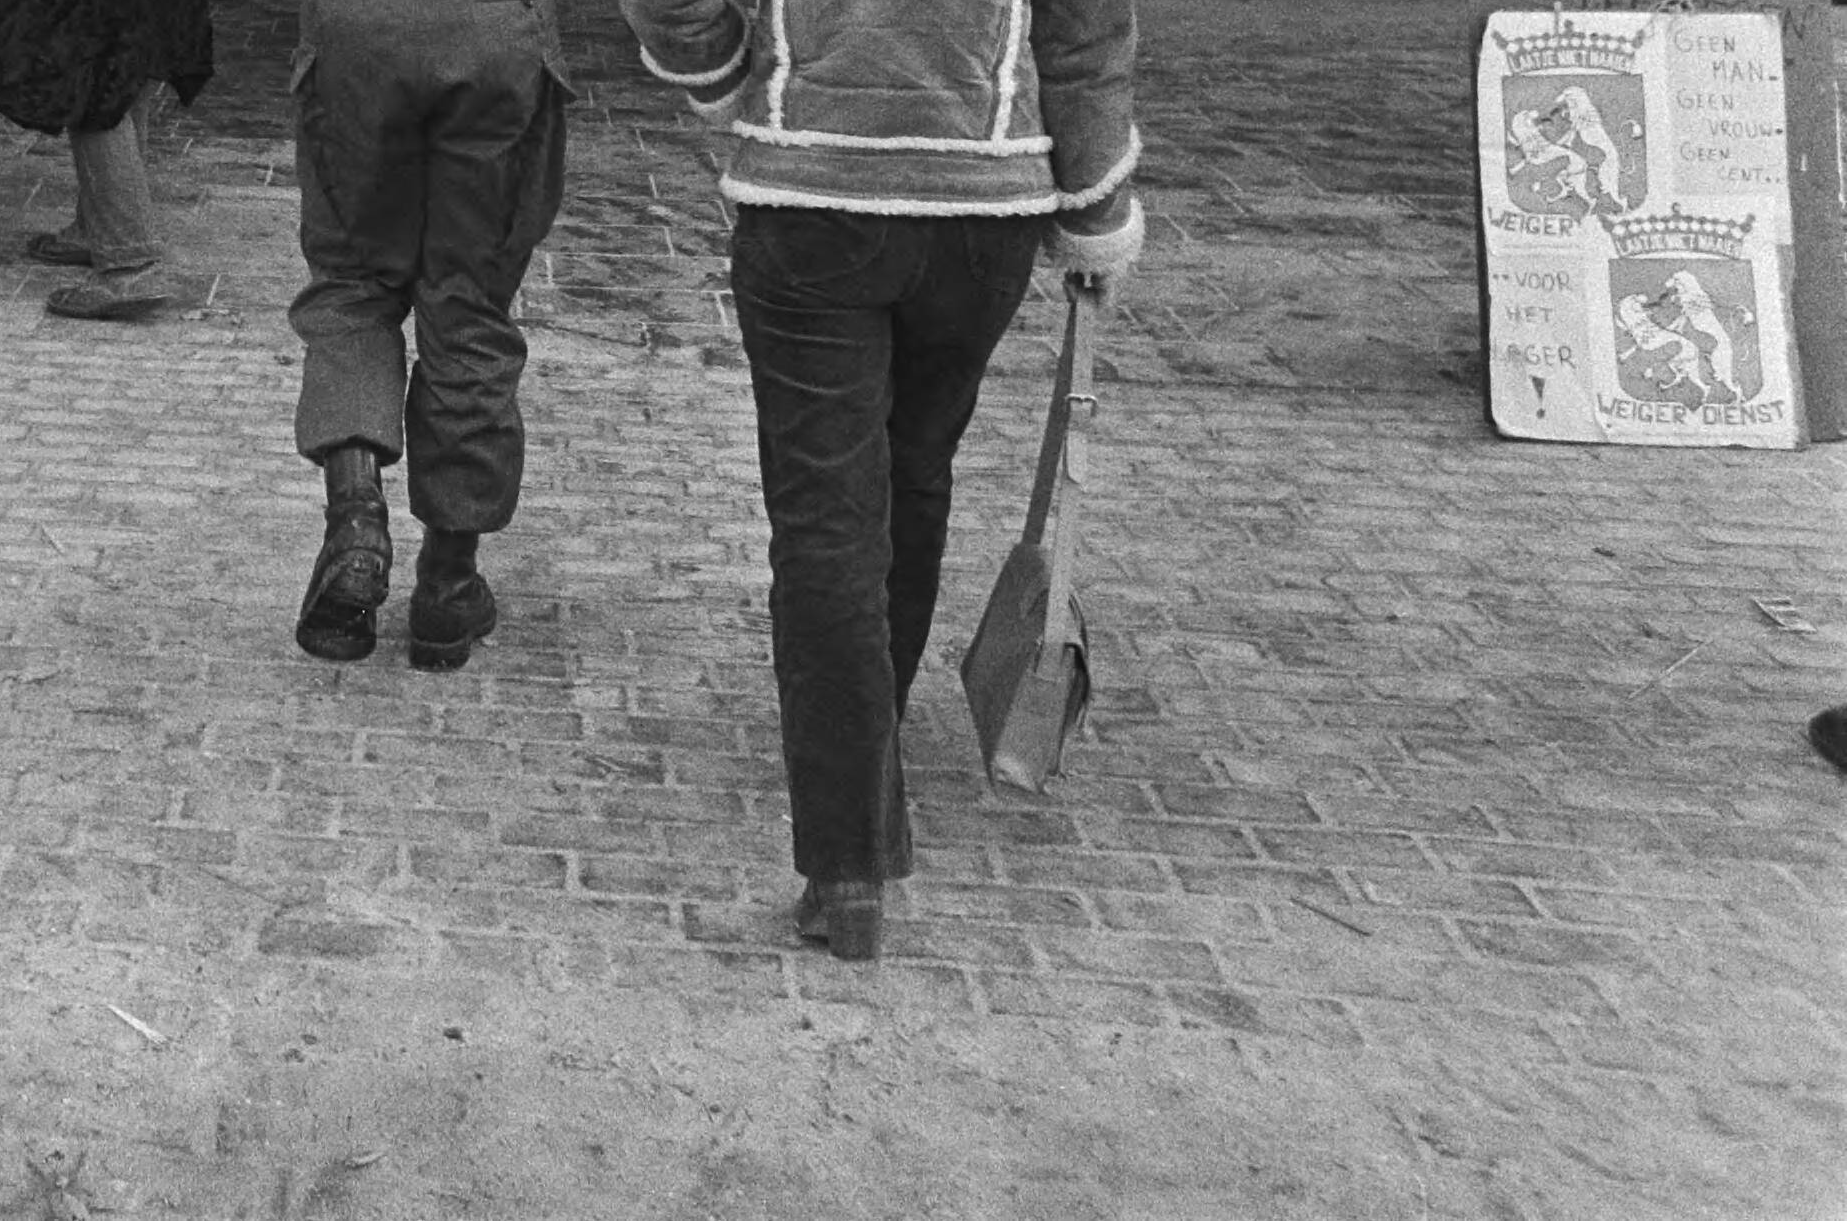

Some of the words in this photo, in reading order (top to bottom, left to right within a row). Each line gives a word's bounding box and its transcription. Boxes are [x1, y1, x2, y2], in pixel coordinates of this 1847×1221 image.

[1673, 27, 1736, 53] GEEN
[1676, 88, 1734, 111] GEEN
[1680, 141, 1730, 162] GEEN
[1487, 206, 1575, 237] WEIGER
[1505, 305, 1553, 323] HET
[1597, 392, 1687, 424] WEIGER
[1702, 399, 1786, 425] DIENST
